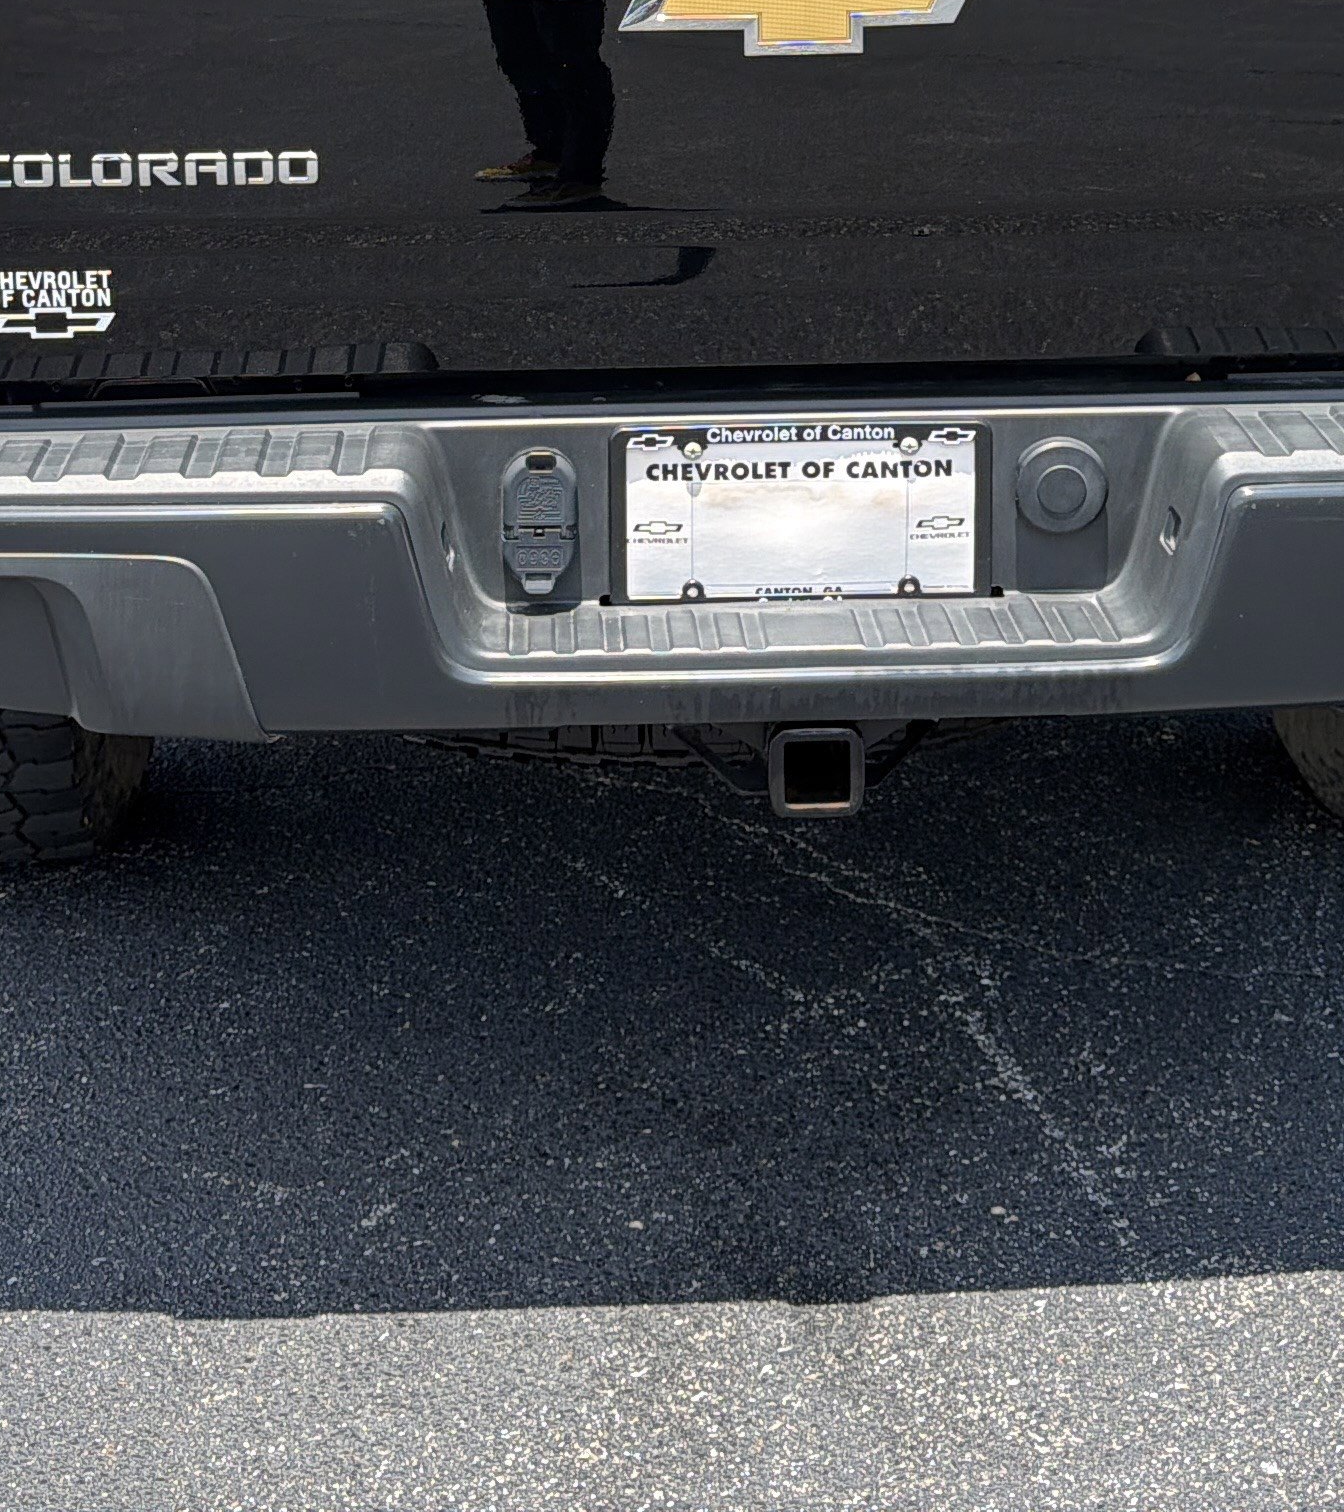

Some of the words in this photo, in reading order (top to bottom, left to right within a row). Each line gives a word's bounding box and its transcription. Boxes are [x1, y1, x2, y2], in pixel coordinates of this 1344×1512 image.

[22, 288, 112, 308] CANTON
[706, 426, 798, 443] Chevrolet
[802, 425, 823, 441] of
[827, 424, 895, 441] Canton
[646, 461, 791, 481] CHEVROLET
[801, 461, 835, 478] OF
[846, 459, 953, 479] CANTON
